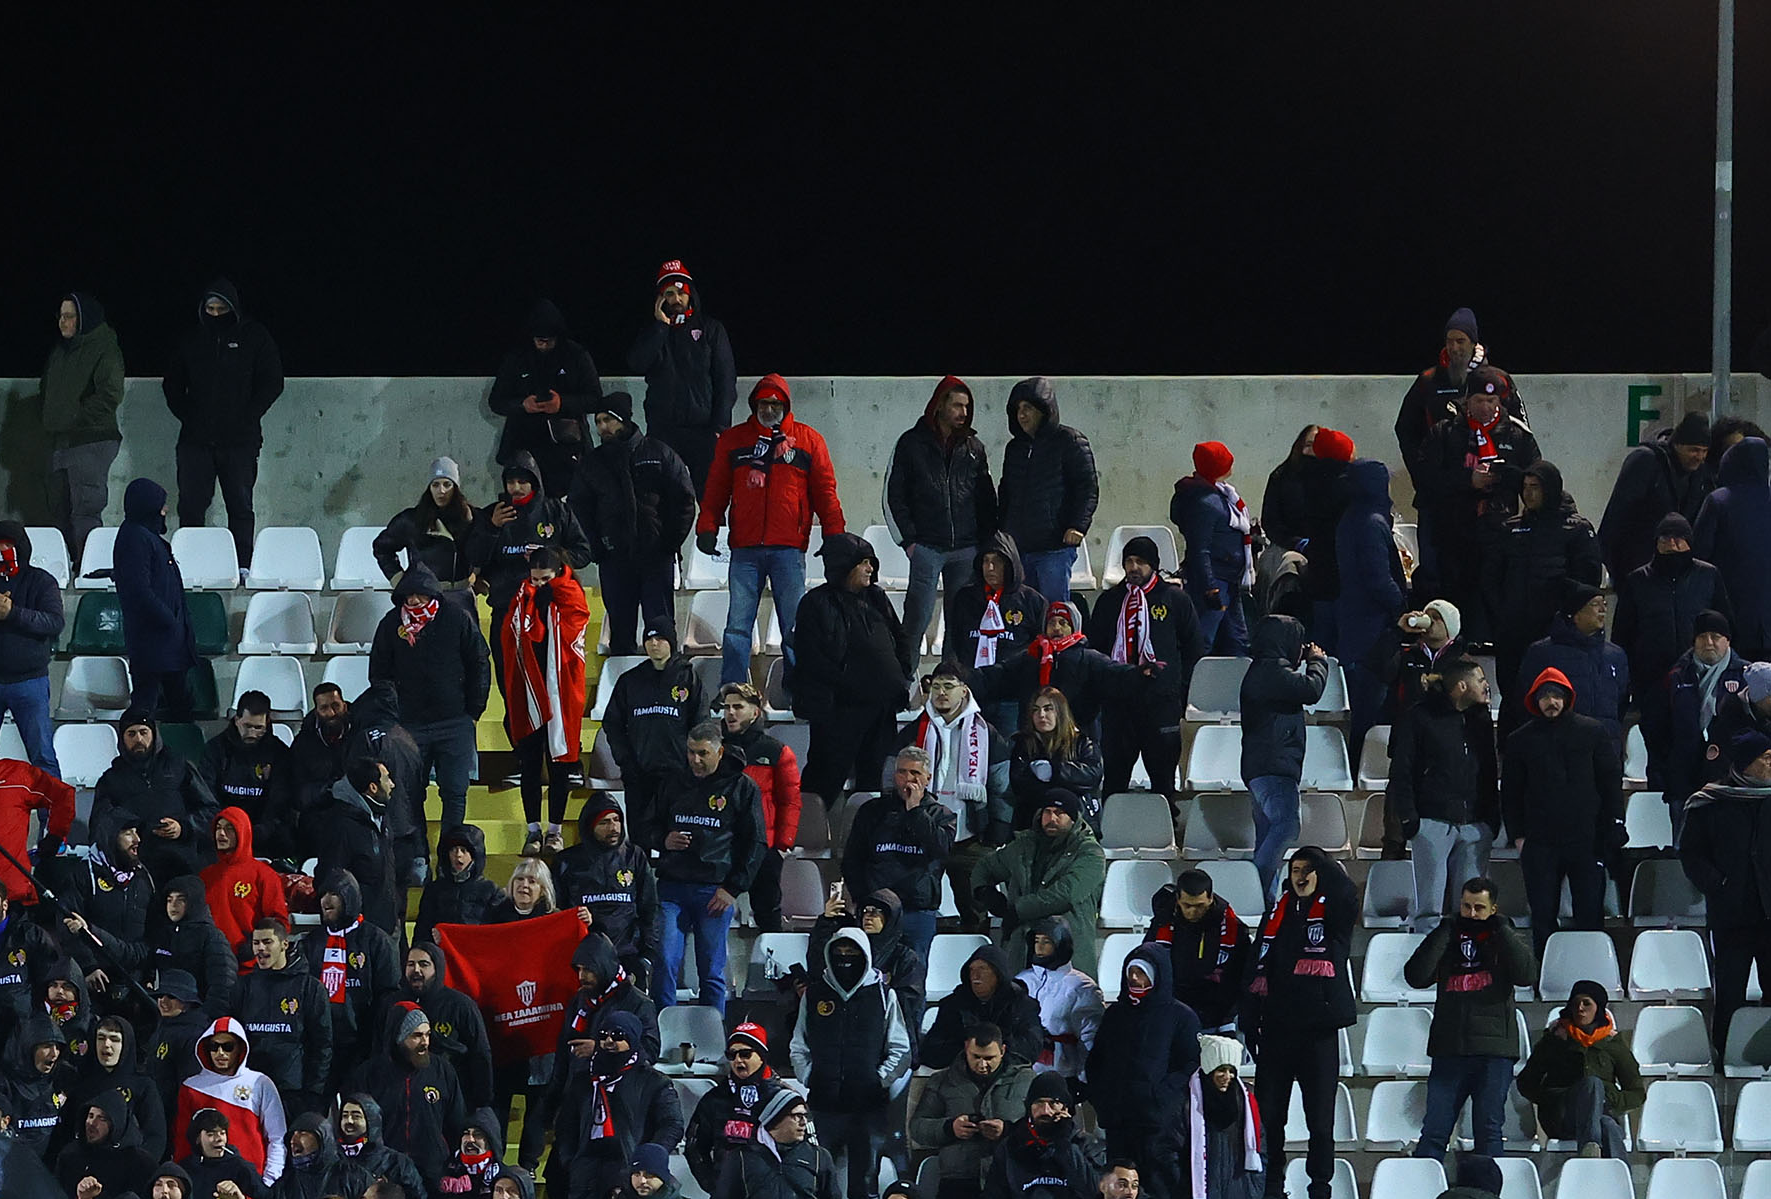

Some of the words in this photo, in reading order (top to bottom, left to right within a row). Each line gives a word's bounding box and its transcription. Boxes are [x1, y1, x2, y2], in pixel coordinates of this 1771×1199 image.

[633, 705, 679, 718] FAMAGUSTA
[674, 814, 721, 829] FAMAGUSTA
[876, 842, 924, 856] FAMAGUSTA
[582, 892, 632, 905] FAMAGUSTA
[18, 1115, 61, 1130] FAMAGUS
